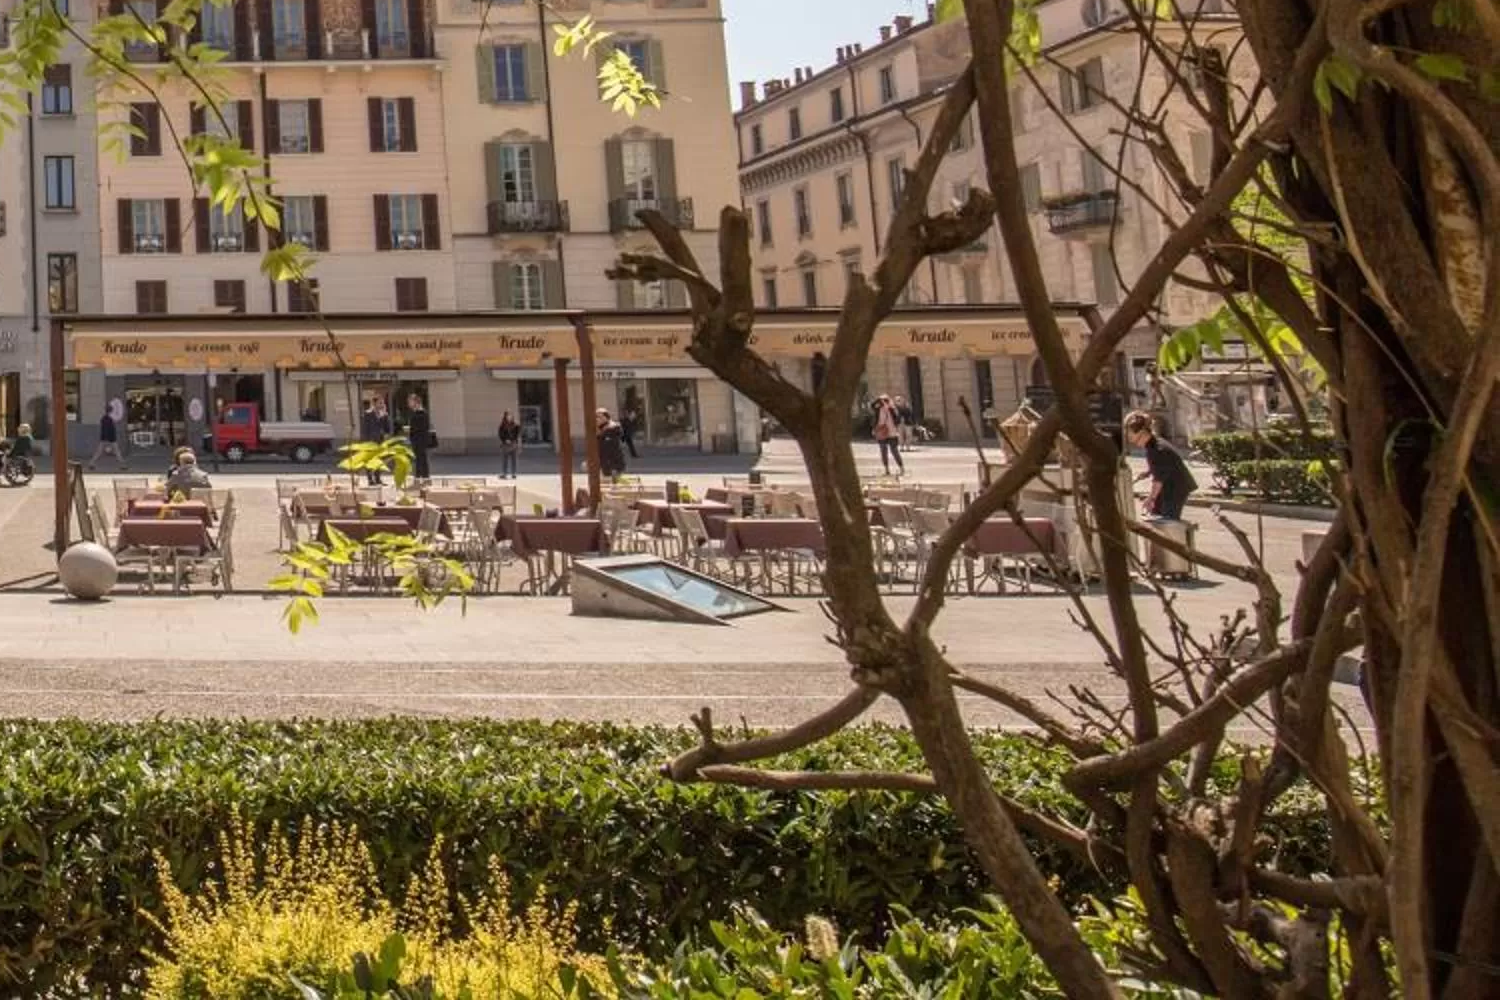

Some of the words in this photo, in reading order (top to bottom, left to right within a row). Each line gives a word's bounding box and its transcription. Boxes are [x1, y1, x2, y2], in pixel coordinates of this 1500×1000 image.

[497, 334, 546, 350] Krudo
[907, 327, 957, 343] Krudo
[100, 338, 148, 354] Krudo
[381, 338, 413, 350] drink
[415, 338, 437, 350] and
